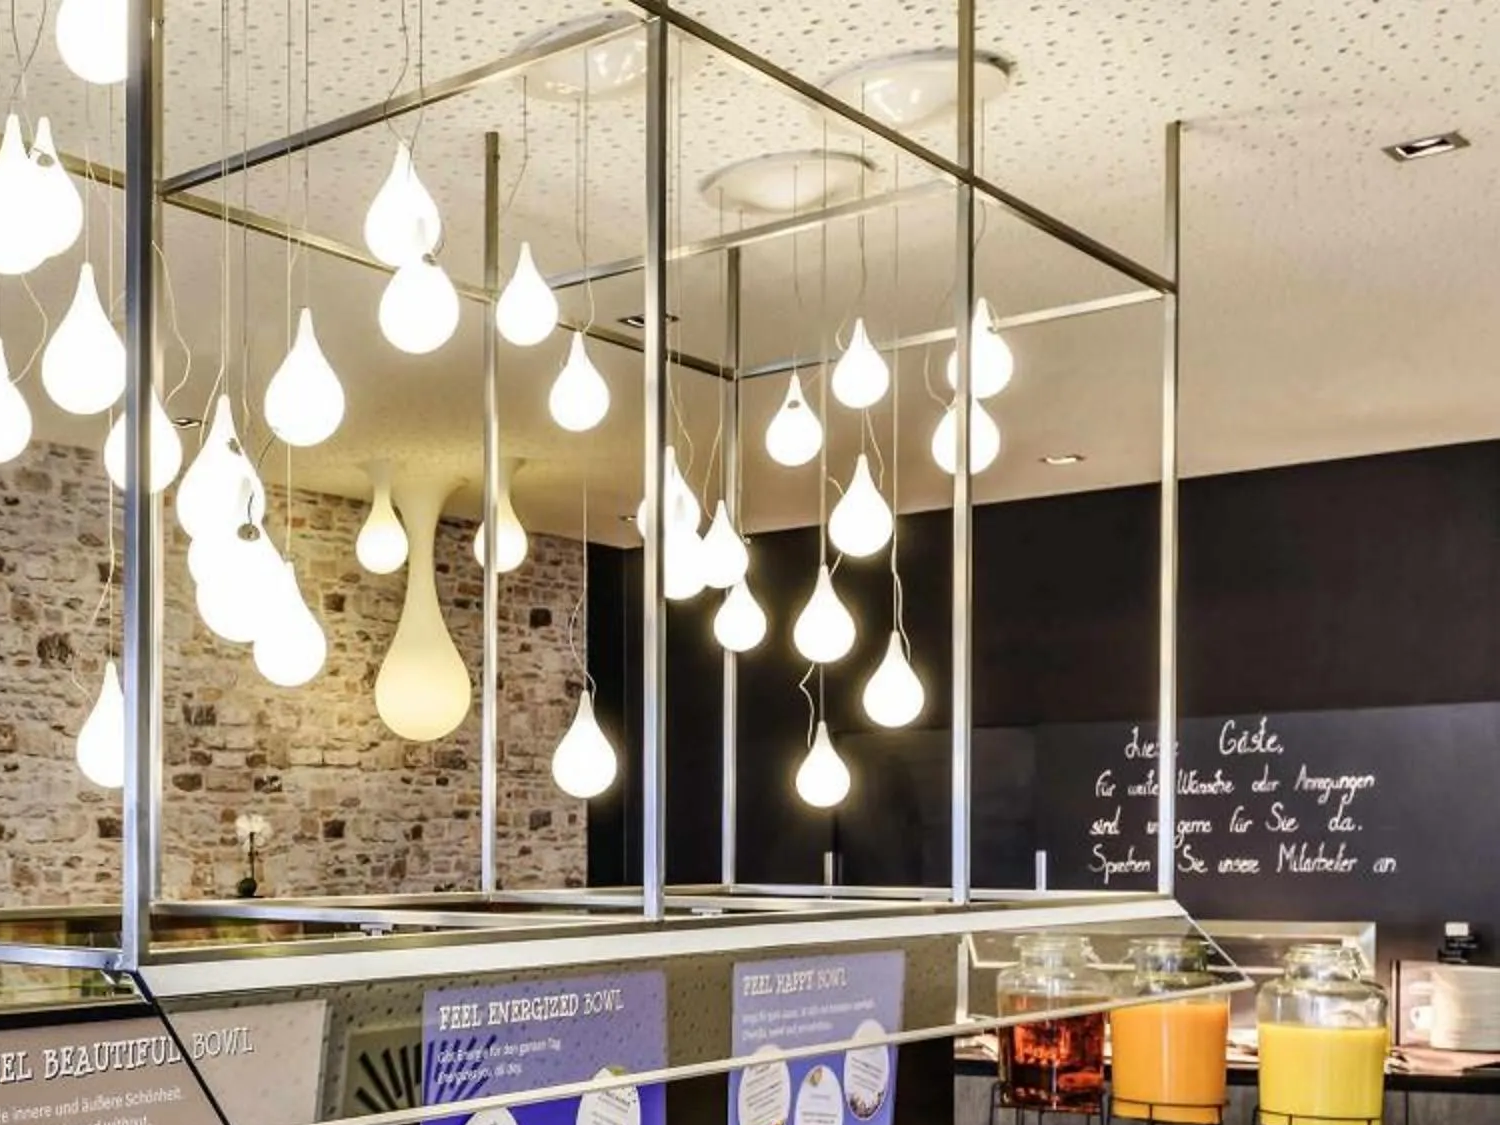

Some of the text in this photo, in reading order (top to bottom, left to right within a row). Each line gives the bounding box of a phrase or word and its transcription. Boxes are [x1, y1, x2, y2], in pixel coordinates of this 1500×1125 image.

[1127, 769, 1160, 796] weite
[1251, 762, 1280, 792] oder
[1294, 763, 1375, 805] Anregungen
[1089, 805, 1121, 835] sind
[1265, 802, 1299, 831] Sie
[1328, 802, 1362, 831] da.
[1178, 844, 1208, 873] Sie
[742, 966, 848, 996] FEEL HAPPY BOWL
[439, 989, 624, 1031] FEEL ENERGIZED BOWL
[44, 1035, 183, 1080] BEAUTIFUL
[192, 1027, 254, 1060] BOWL
[13, 1103, 51, 1122] innere
[55, 1098, 79, 1117] und
